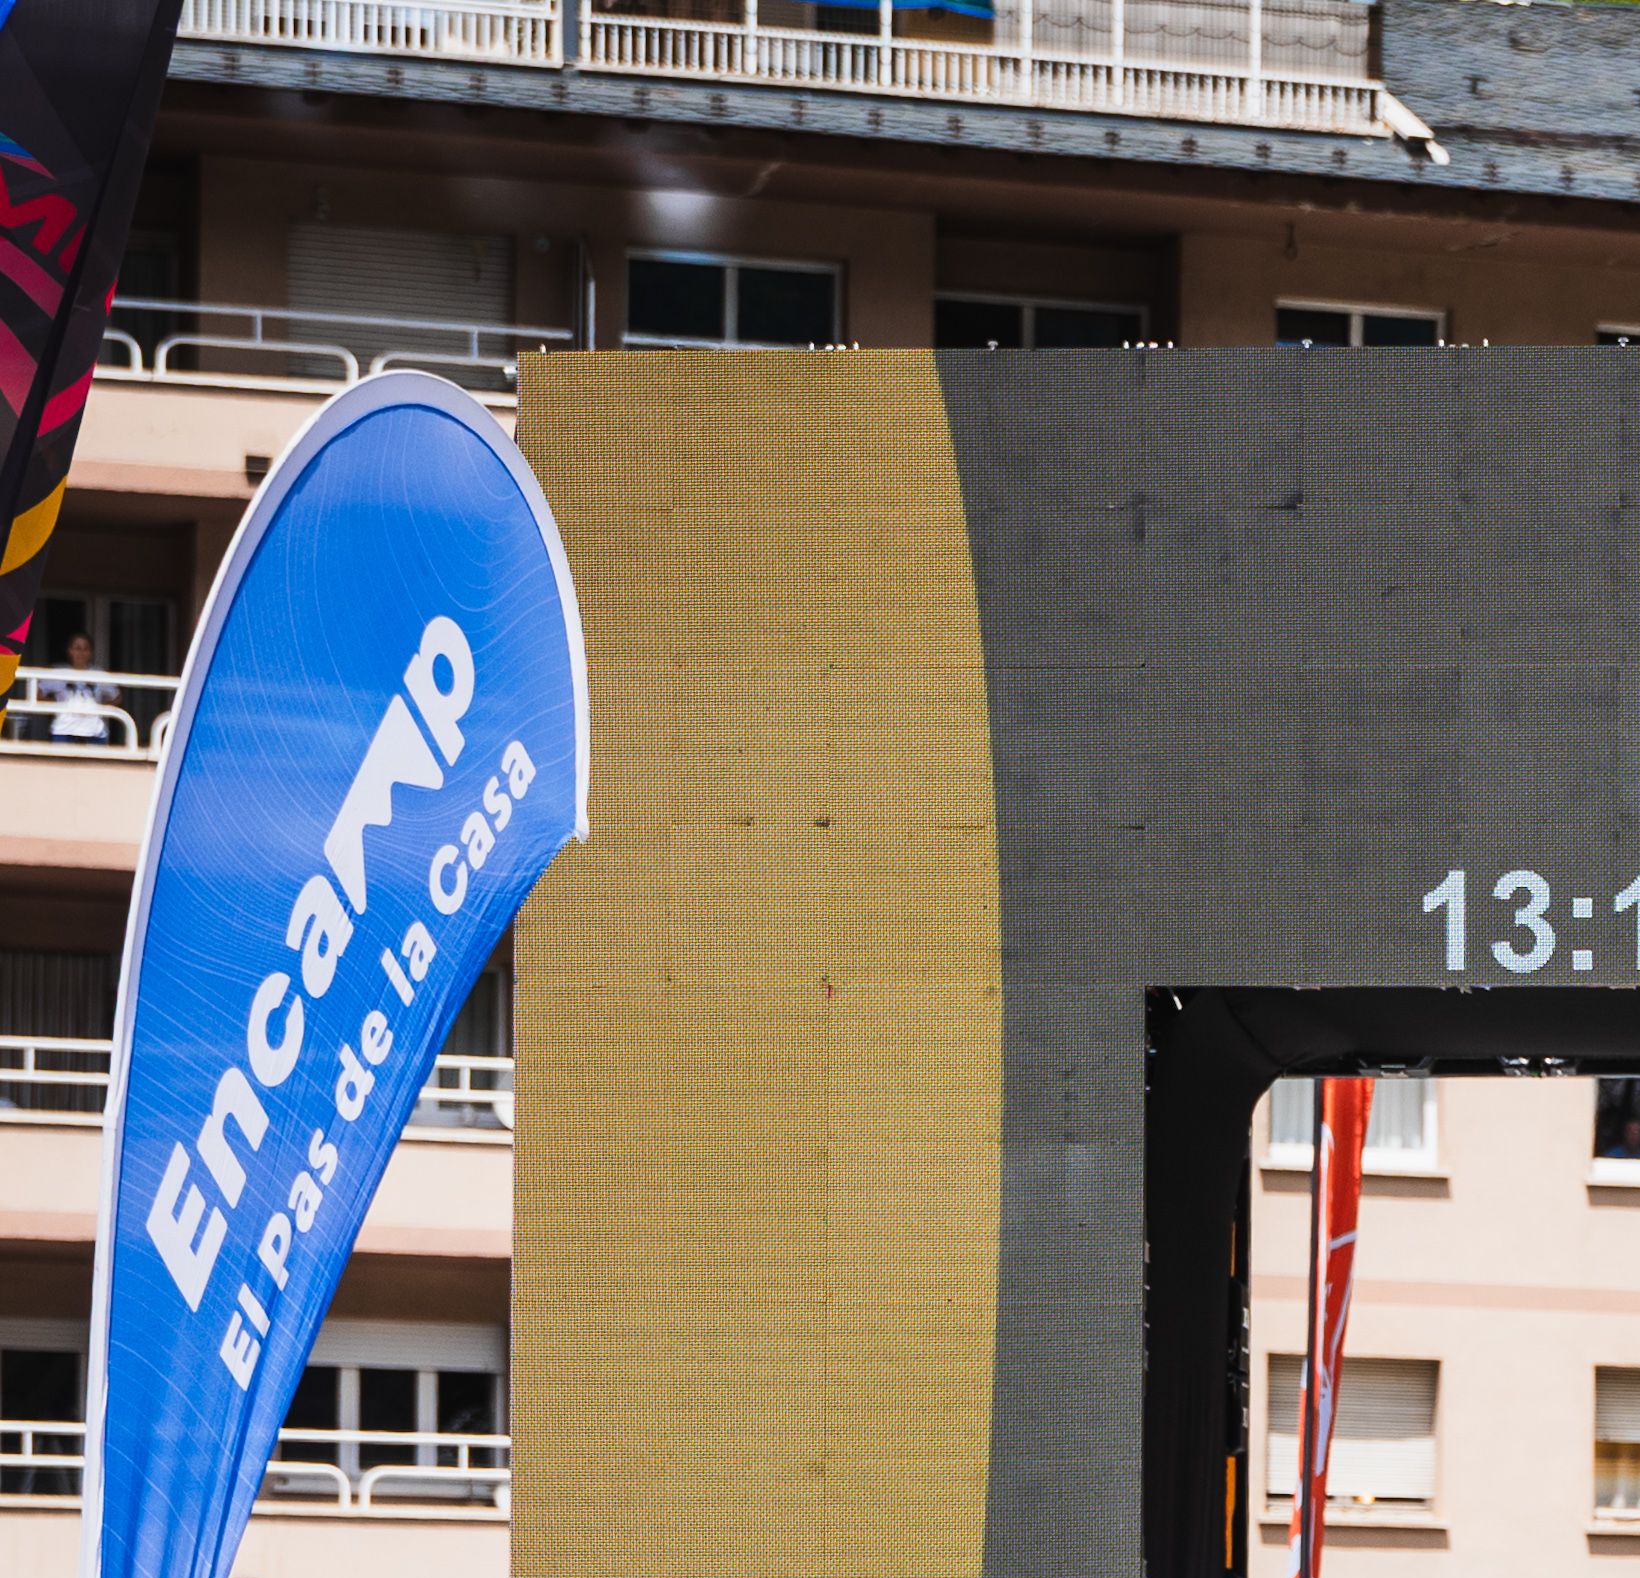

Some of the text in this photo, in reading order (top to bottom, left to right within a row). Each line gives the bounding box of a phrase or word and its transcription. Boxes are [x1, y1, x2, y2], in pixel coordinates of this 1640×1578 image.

[146, 616, 476, 1313] Encamp
[219, 740, 537, 1391] El Pas de la Casa
